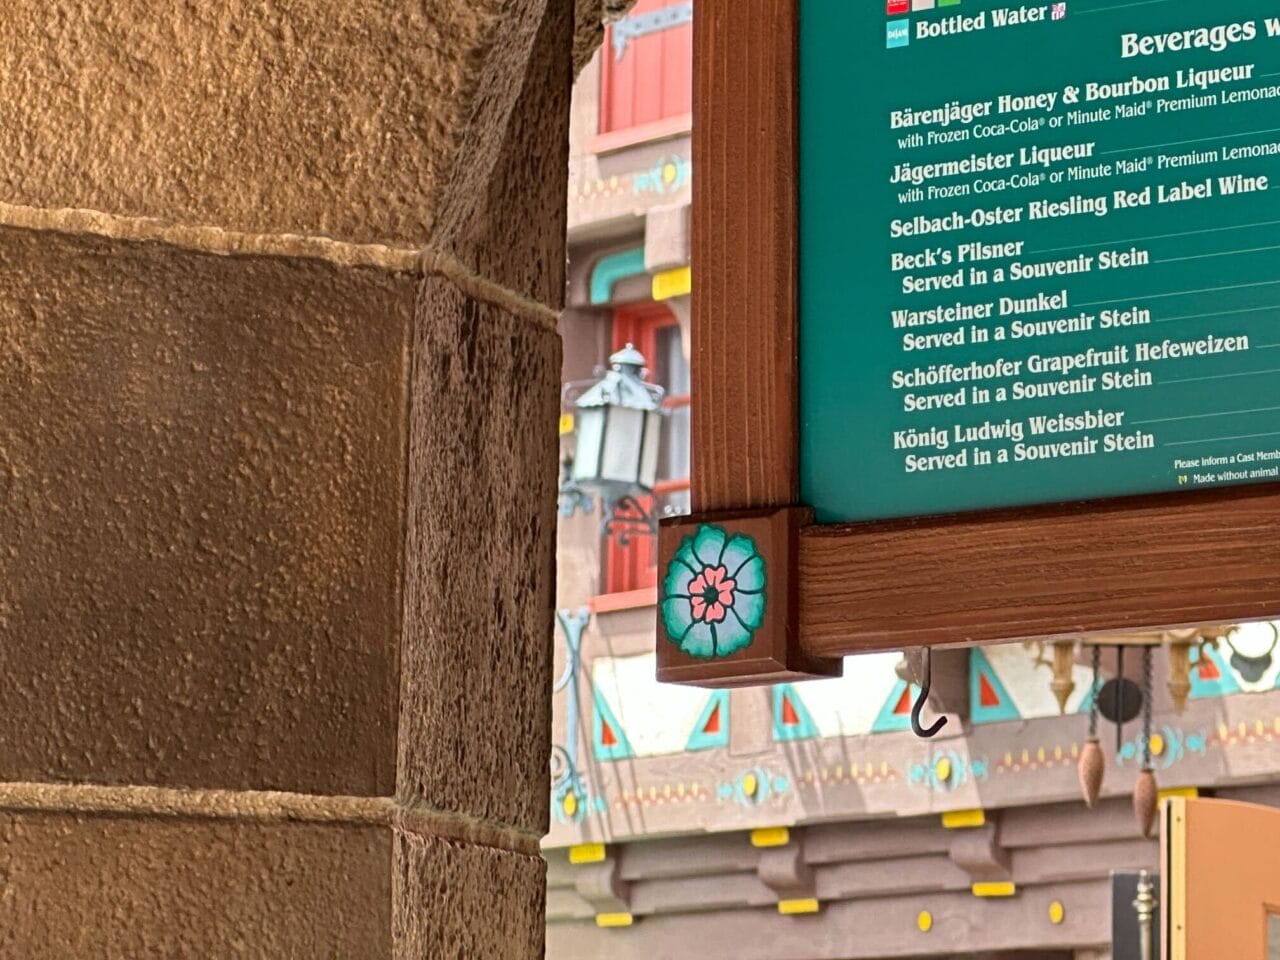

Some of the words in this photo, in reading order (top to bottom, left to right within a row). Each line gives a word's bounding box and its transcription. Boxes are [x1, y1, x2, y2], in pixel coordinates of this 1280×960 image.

[916, 11, 986, 39] Bottled
[991, 5, 1048, 27] Water
[1121, 21, 1257, 58] Beverages
[890, 101, 993, 129] Bärenjäger
[998, 92, 1058, 114] Honey
[1062, 85, 1080, 105] &
[1085, 76, 1170, 101] Bourbon
[1176, 64, 1255, 90] Liqueur
[897, 133, 924, 149] with
[927, 129, 970, 145] Frozen
[1048, 116, 1063, 128] or
[1067, 108, 1111, 125] Minute
[1156, 94, 1217, 113] Premium
[889, 152, 1015, 185] Jägermeister
[1019, 142, 1095, 168] Liqueur
[898, 187, 924, 204] with
[928, 184, 970, 200] Frozen
[1049, 171, 1064, 183] or
[1067, 164, 1112, 181] Minute
[1157, 150, 1218, 169] Premium
[890, 206, 1023, 238] Selbach-Oster
[1029, 195, 1108, 220] Riesling
[1113, 186, 1151, 209] Red
[1157, 178, 1212, 204] Label
[1218, 174, 1268, 195] Wine
[902, 268, 964, 294] Served
[970, 267, 988, 286] in
[992, 268, 1005, 283] a
[1010, 254, 1094, 281] Souvenir
[1098, 247, 1149, 270] Stein
[958, 241, 1024, 263] Pilsner
[891, 302, 994, 329] Warsteiner
[999, 289, 1068, 316] Dunkel
[903, 326, 965, 351] Served
[971, 325, 989, 343] in
[994, 326, 1006, 341] a
[1011, 312, 1095, 339] Souvenir
[1099, 306, 1151, 329] Stein
[892, 358, 1023, 389] Schöfferhofer
[1027, 345, 1130, 375] Grapefruit
[1135, 334, 1249, 362] Hefeweizen
[904, 387, 966, 412] Served
[972, 386, 990, 405] in
[995, 387, 1007, 402] a
[1012, 374, 1097, 400] Souvenir
[1101, 368, 1153, 391] Stein
[893, 426, 949, 450] König
[954, 419, 1025, 443] Ludwig
[1028, 409, 1125, 435] Weissbier
[905, 448, 968, 473] Served
[973, 447, 992, 466] in
[996, 448, 1009, 464] a
[1014, 435, 1099, 462] Souvenir
[1103, 430, 1155, 453] Stein
[1174, 459, 1200, 469] Please
[1236, 453, 1255, 463] Cast
[1193, 472, 1216, 484] Made
[1216, 470, 1249, 481] without
[1249, 465, 1279, 479] animal
